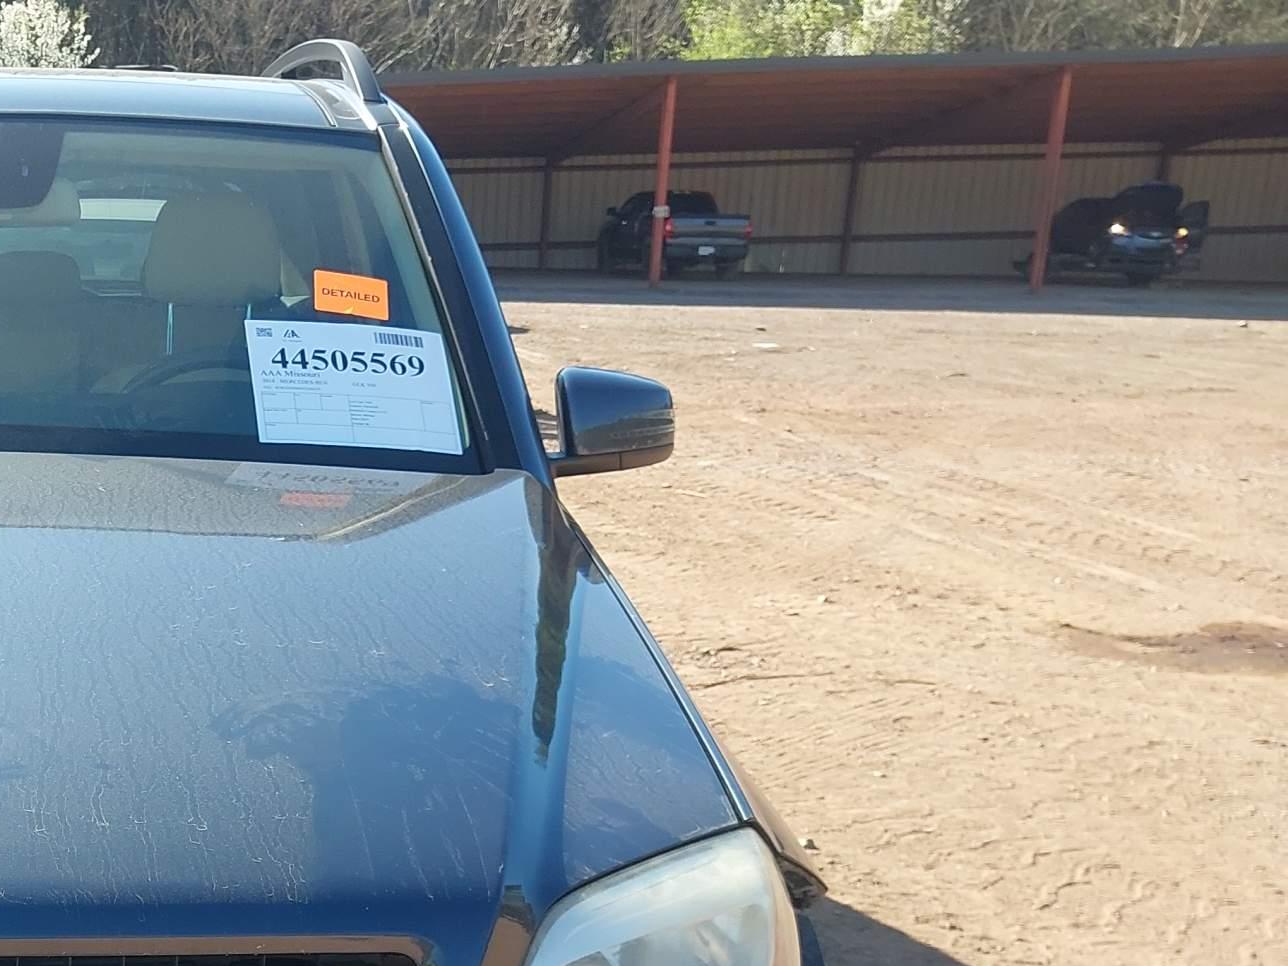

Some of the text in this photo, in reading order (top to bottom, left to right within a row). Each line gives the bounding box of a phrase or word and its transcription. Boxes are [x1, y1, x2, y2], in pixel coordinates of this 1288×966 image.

[321, 287, 380, 303] DETAILED
[271, 347, 425, 377] 44505569
[260, 369, 282, 377] AAA
